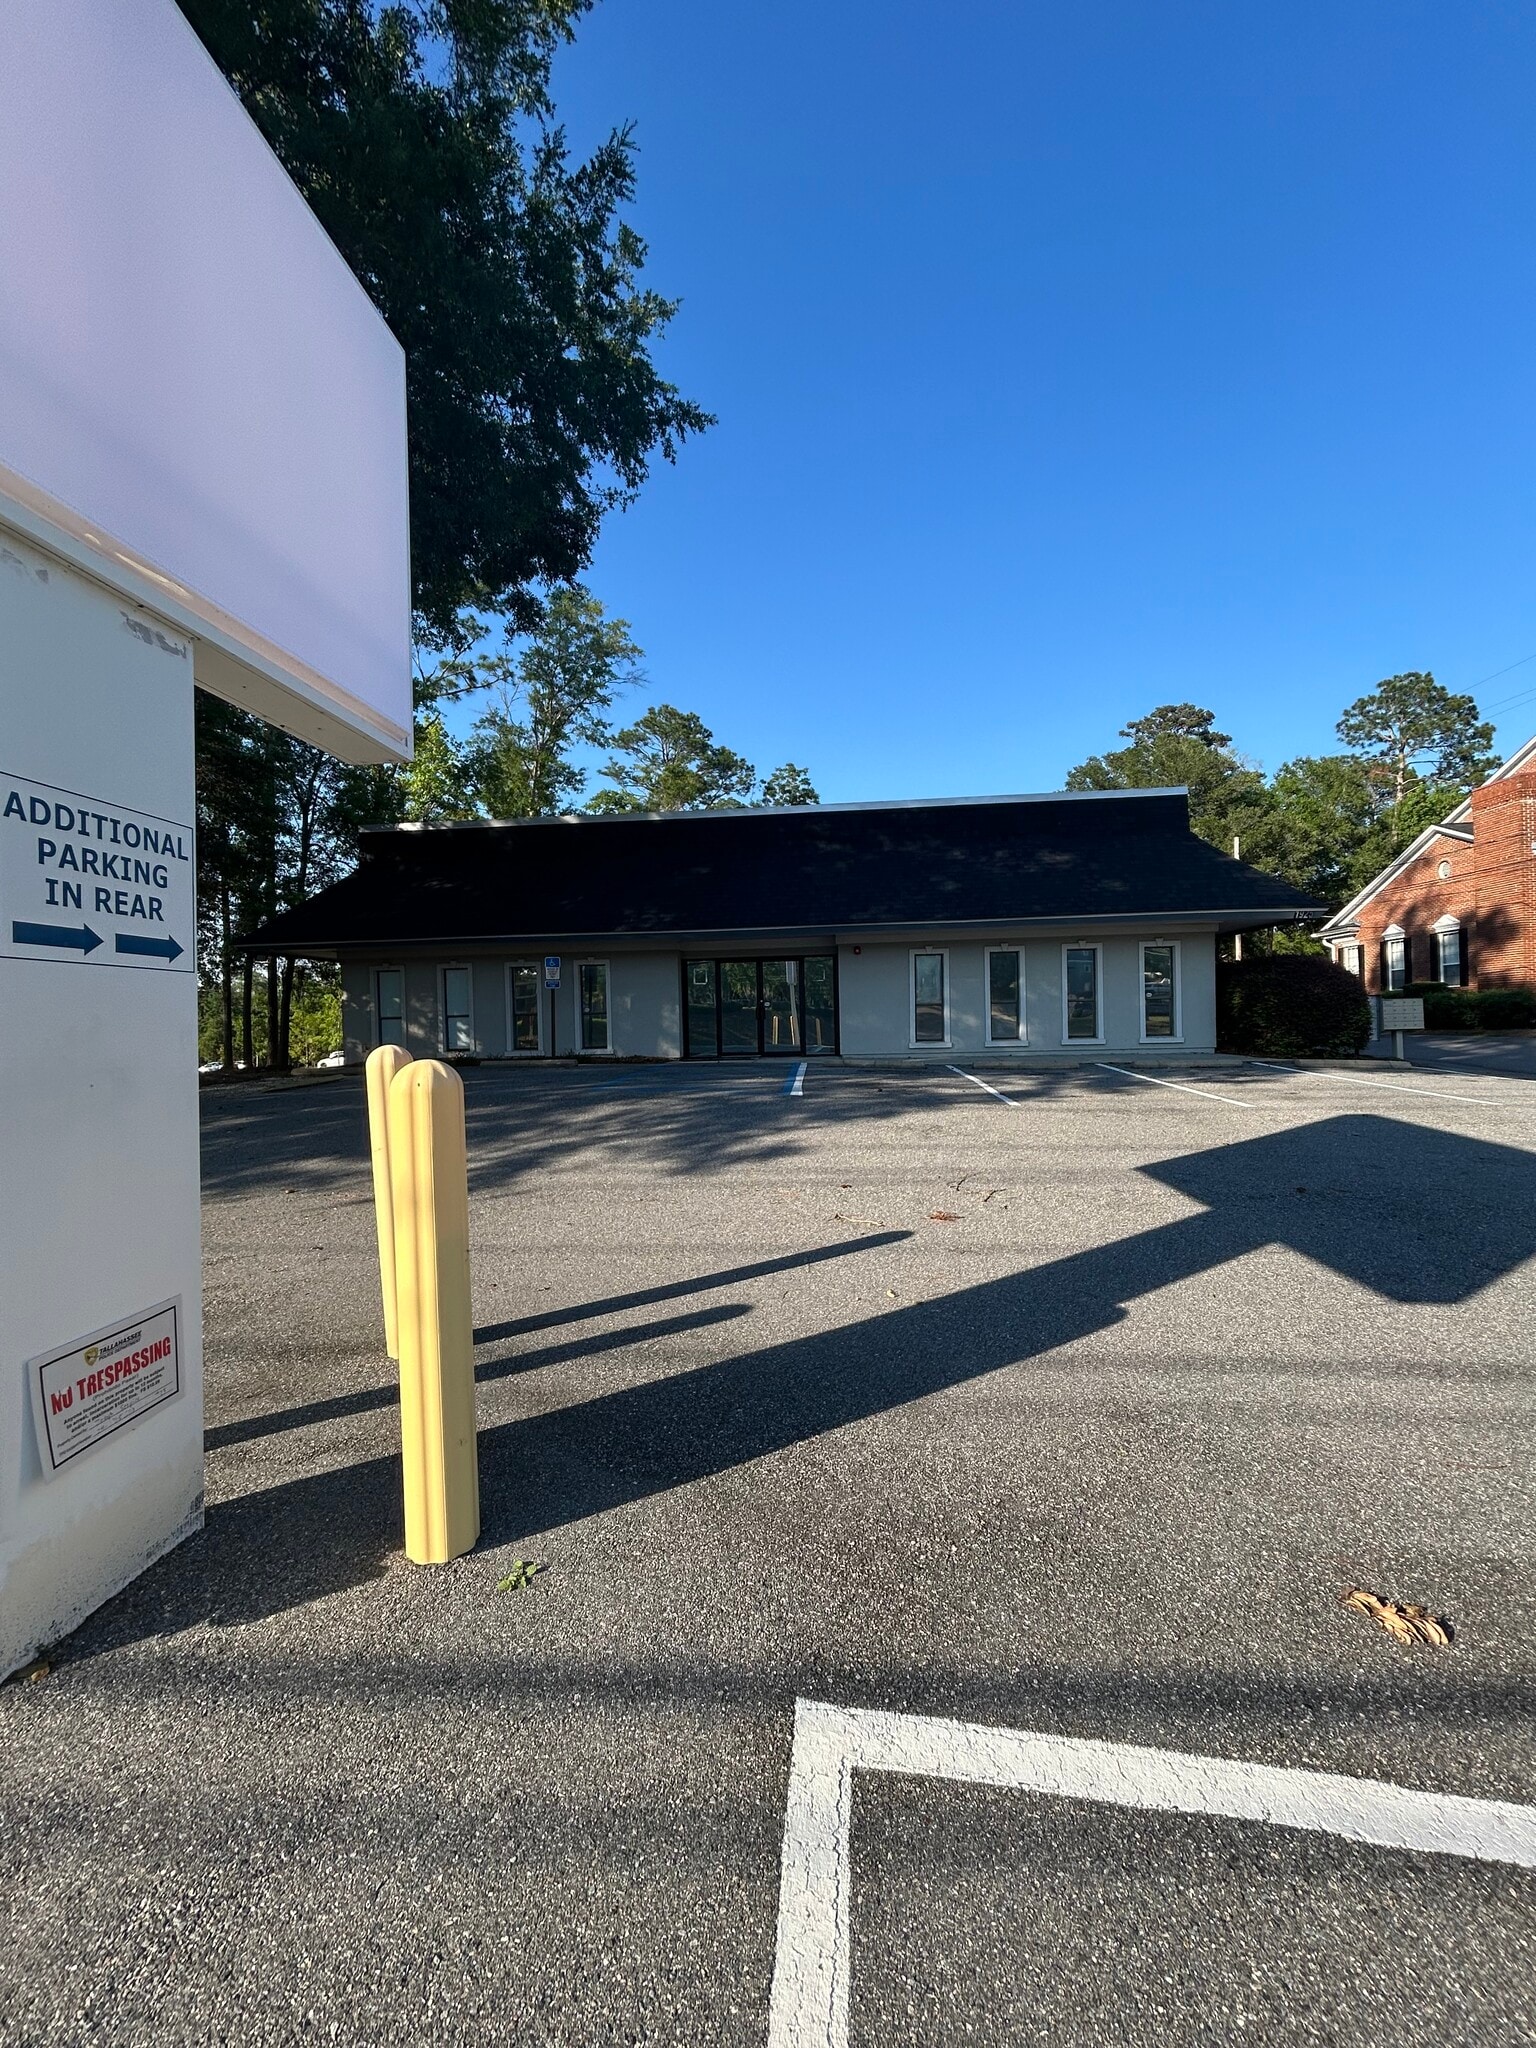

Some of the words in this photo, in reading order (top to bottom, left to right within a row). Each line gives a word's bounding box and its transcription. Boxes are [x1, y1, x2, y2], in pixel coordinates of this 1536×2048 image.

[3, 791, 189, 861] ADDITIONAL
[38, 837, 168, 889] PARKING
[45, 877, 82, 909] IN
[95, 886, 164, 921] REAR
[99, 1330, 142, 1354] TALLAHASSEE
[76, 1336, 171, 1401] TRESPASSING
